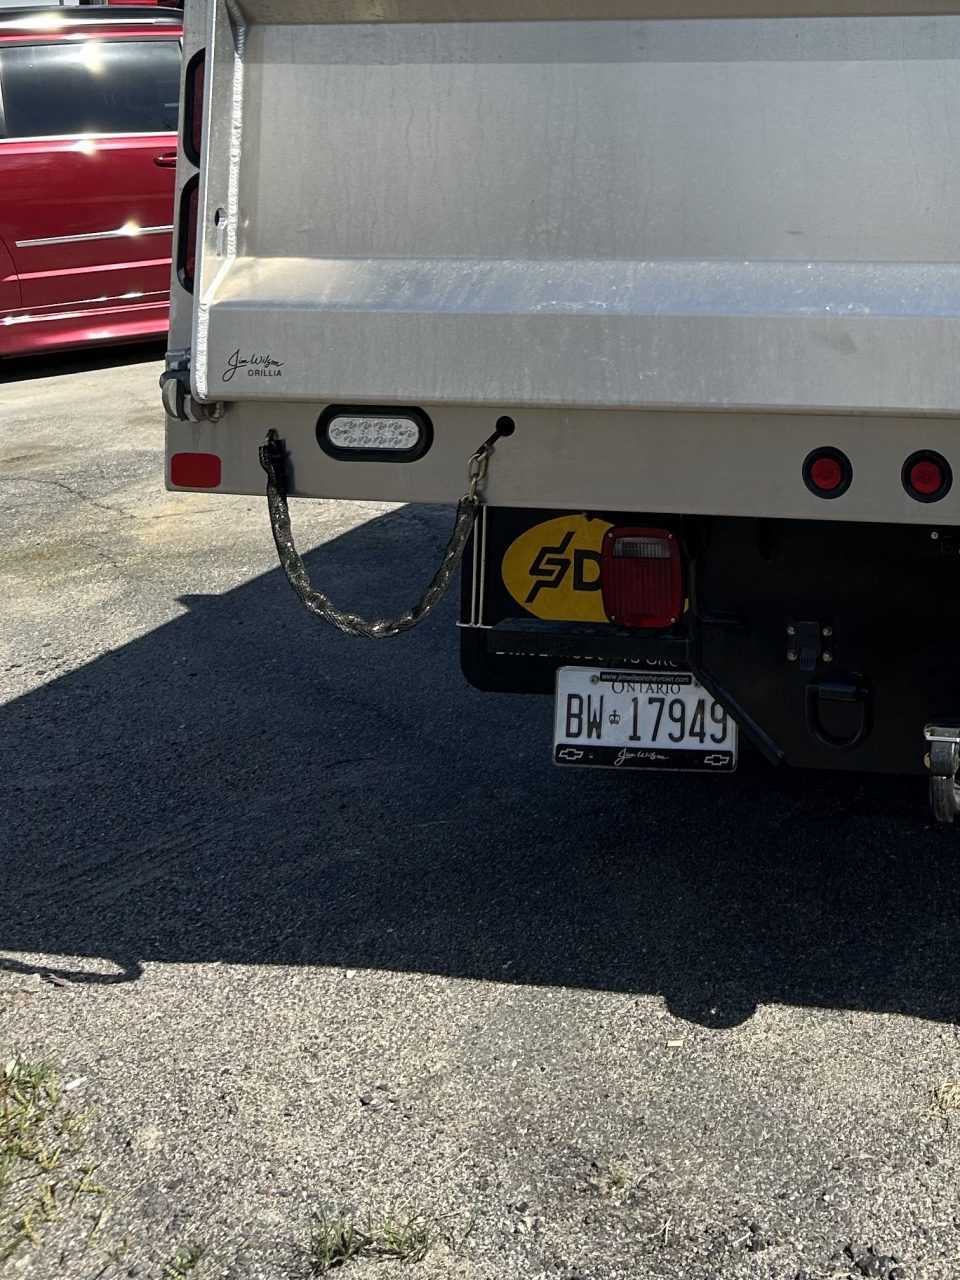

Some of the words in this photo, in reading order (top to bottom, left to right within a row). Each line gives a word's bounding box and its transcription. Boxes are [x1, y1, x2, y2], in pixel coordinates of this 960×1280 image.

[247, 369, 282, 377] ORILLIA
[601, 673, 689, 683] www.jimwilsonchevrolet.com
[611, 680, 682, 696] ONTARIO
[565, 693, 604, 739] BW
[628, 696, 728, 744] 17949
